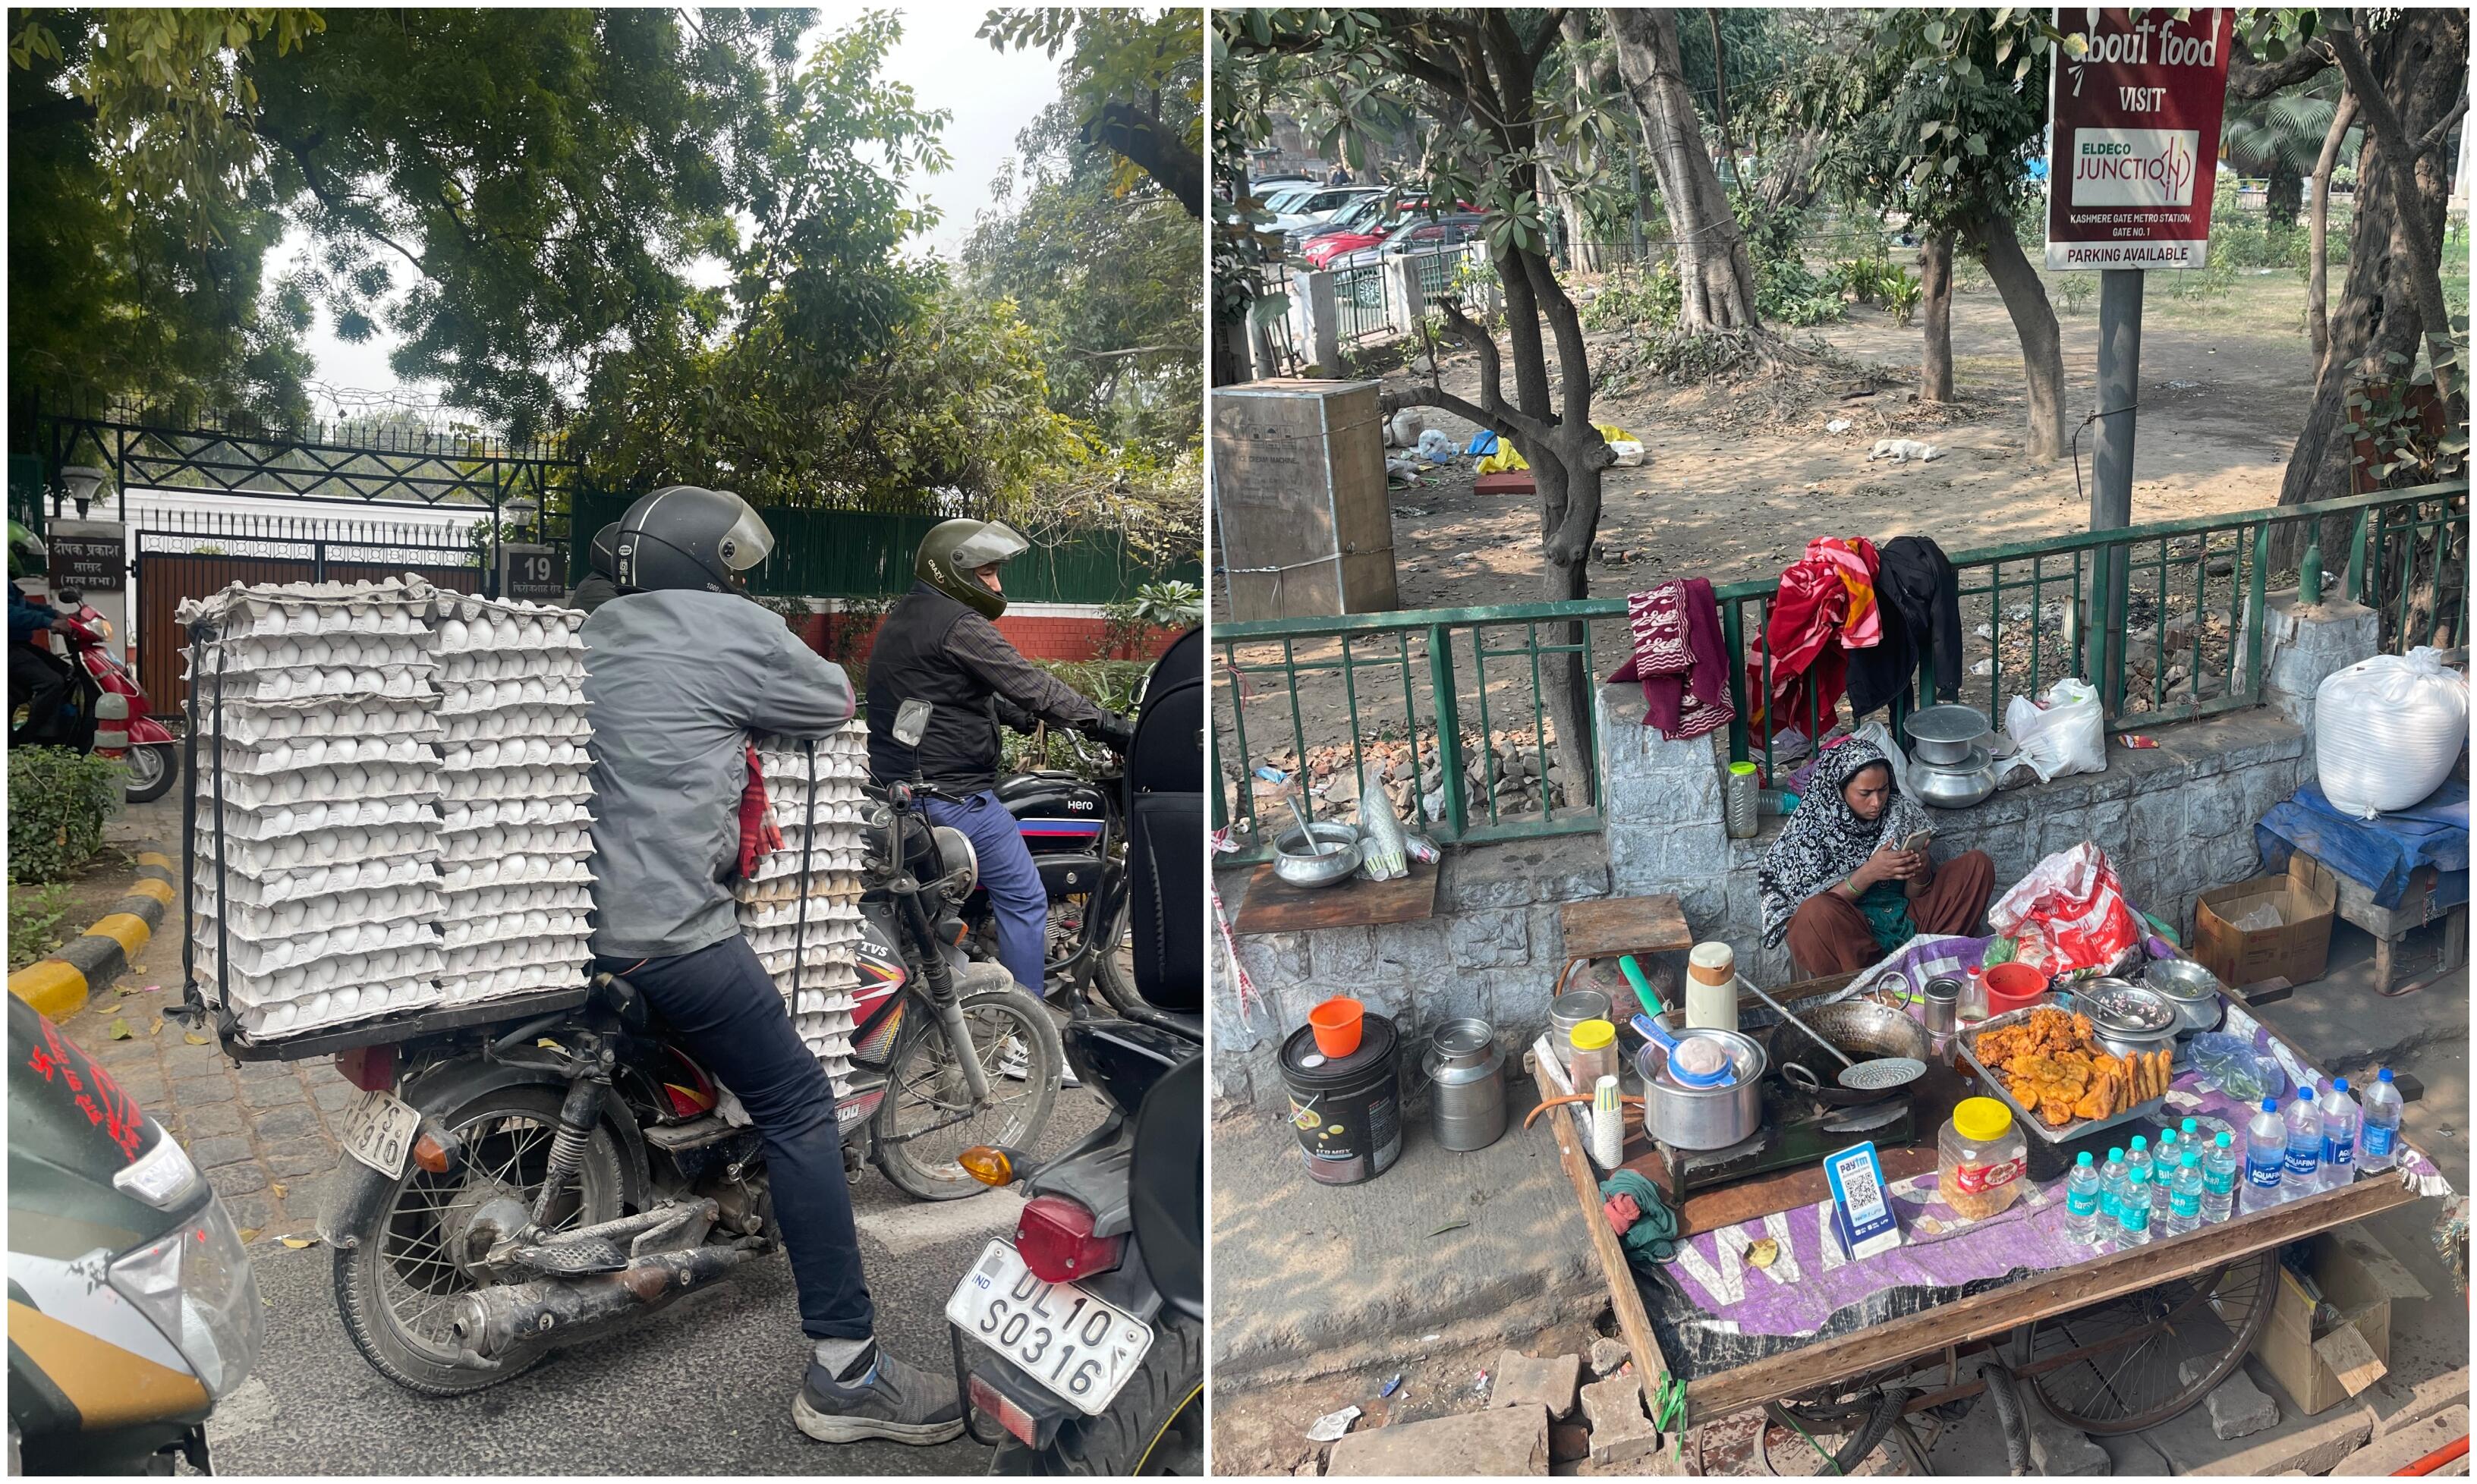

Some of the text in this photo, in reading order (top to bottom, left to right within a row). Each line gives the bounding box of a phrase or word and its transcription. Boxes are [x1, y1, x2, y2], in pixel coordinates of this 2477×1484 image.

[2159, 9, 2224, 67] food
[2119, 86, 2167, 112] VISIT
[2082, 143, 2132, 156] ELDECO
[2070, 213, 2192, 224] KASHMERE GATE METRO STATION,
[2113, 228, 2151, 237] GATE NO. 1
[2067, 247, 2189, 263] PARKING AVAILABLE
[54, 538, 120, 558] दीपक प्रकाश
[73, 559, 102, 573] सांसद
[524, 557, 551, 581] 19
[928, 559, 945, 579] CRAZY
[1067, 800, 1094, 810] Hero
[861, 941, 889, 957] TVS
[2284, 1154, 2316, 1167] AQUAFINA
[2158, 1169, 2173, 1180] Bils
[2252, 1169, 2281, 1181] AQUAFIN
[971, 1274, 990, 1290] IND
[1062, 1297, 1112, 1347] 10
